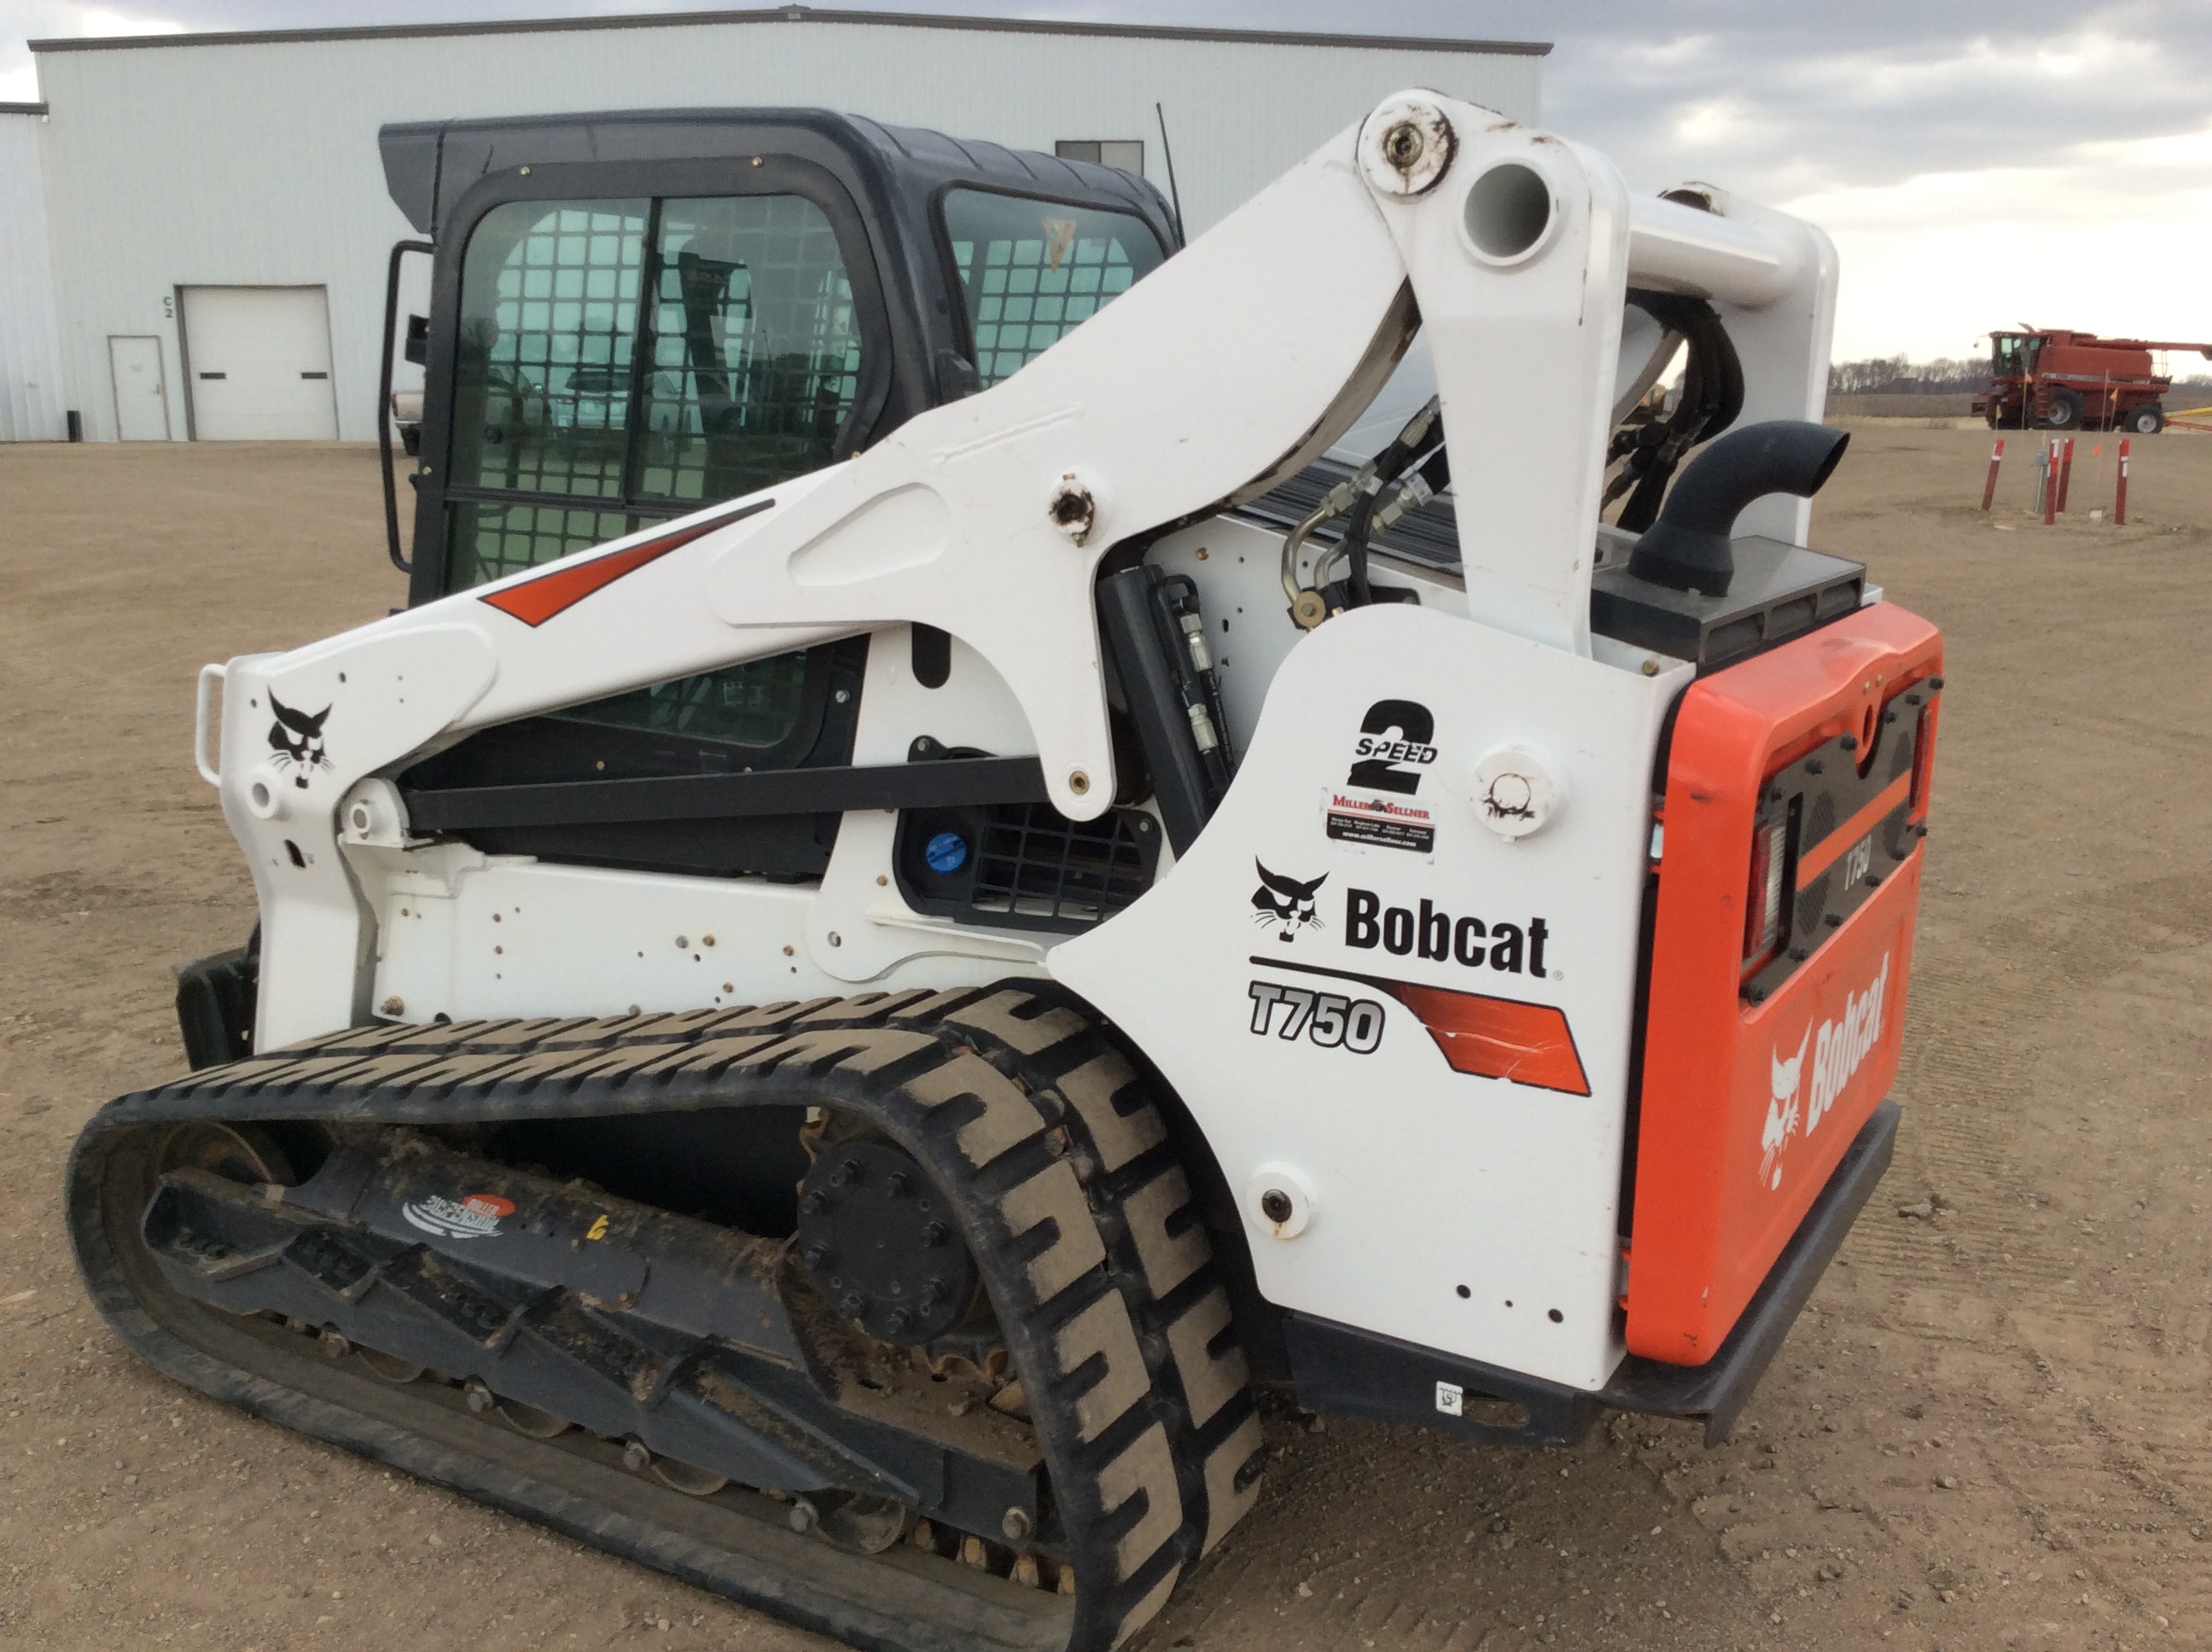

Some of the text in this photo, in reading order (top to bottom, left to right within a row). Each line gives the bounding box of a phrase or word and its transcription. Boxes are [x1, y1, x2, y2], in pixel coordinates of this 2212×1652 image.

[1347, 699, 1435, 795] 2
[1355, 737, 1439, 765] SPEED
[1844, 835, 1872, 891] T750
[1345, 887, 1549, 979] Bobcat
[1248, 980, 1386, 1056] T750
[1806, 951, 1890, 1137] Bobcat
